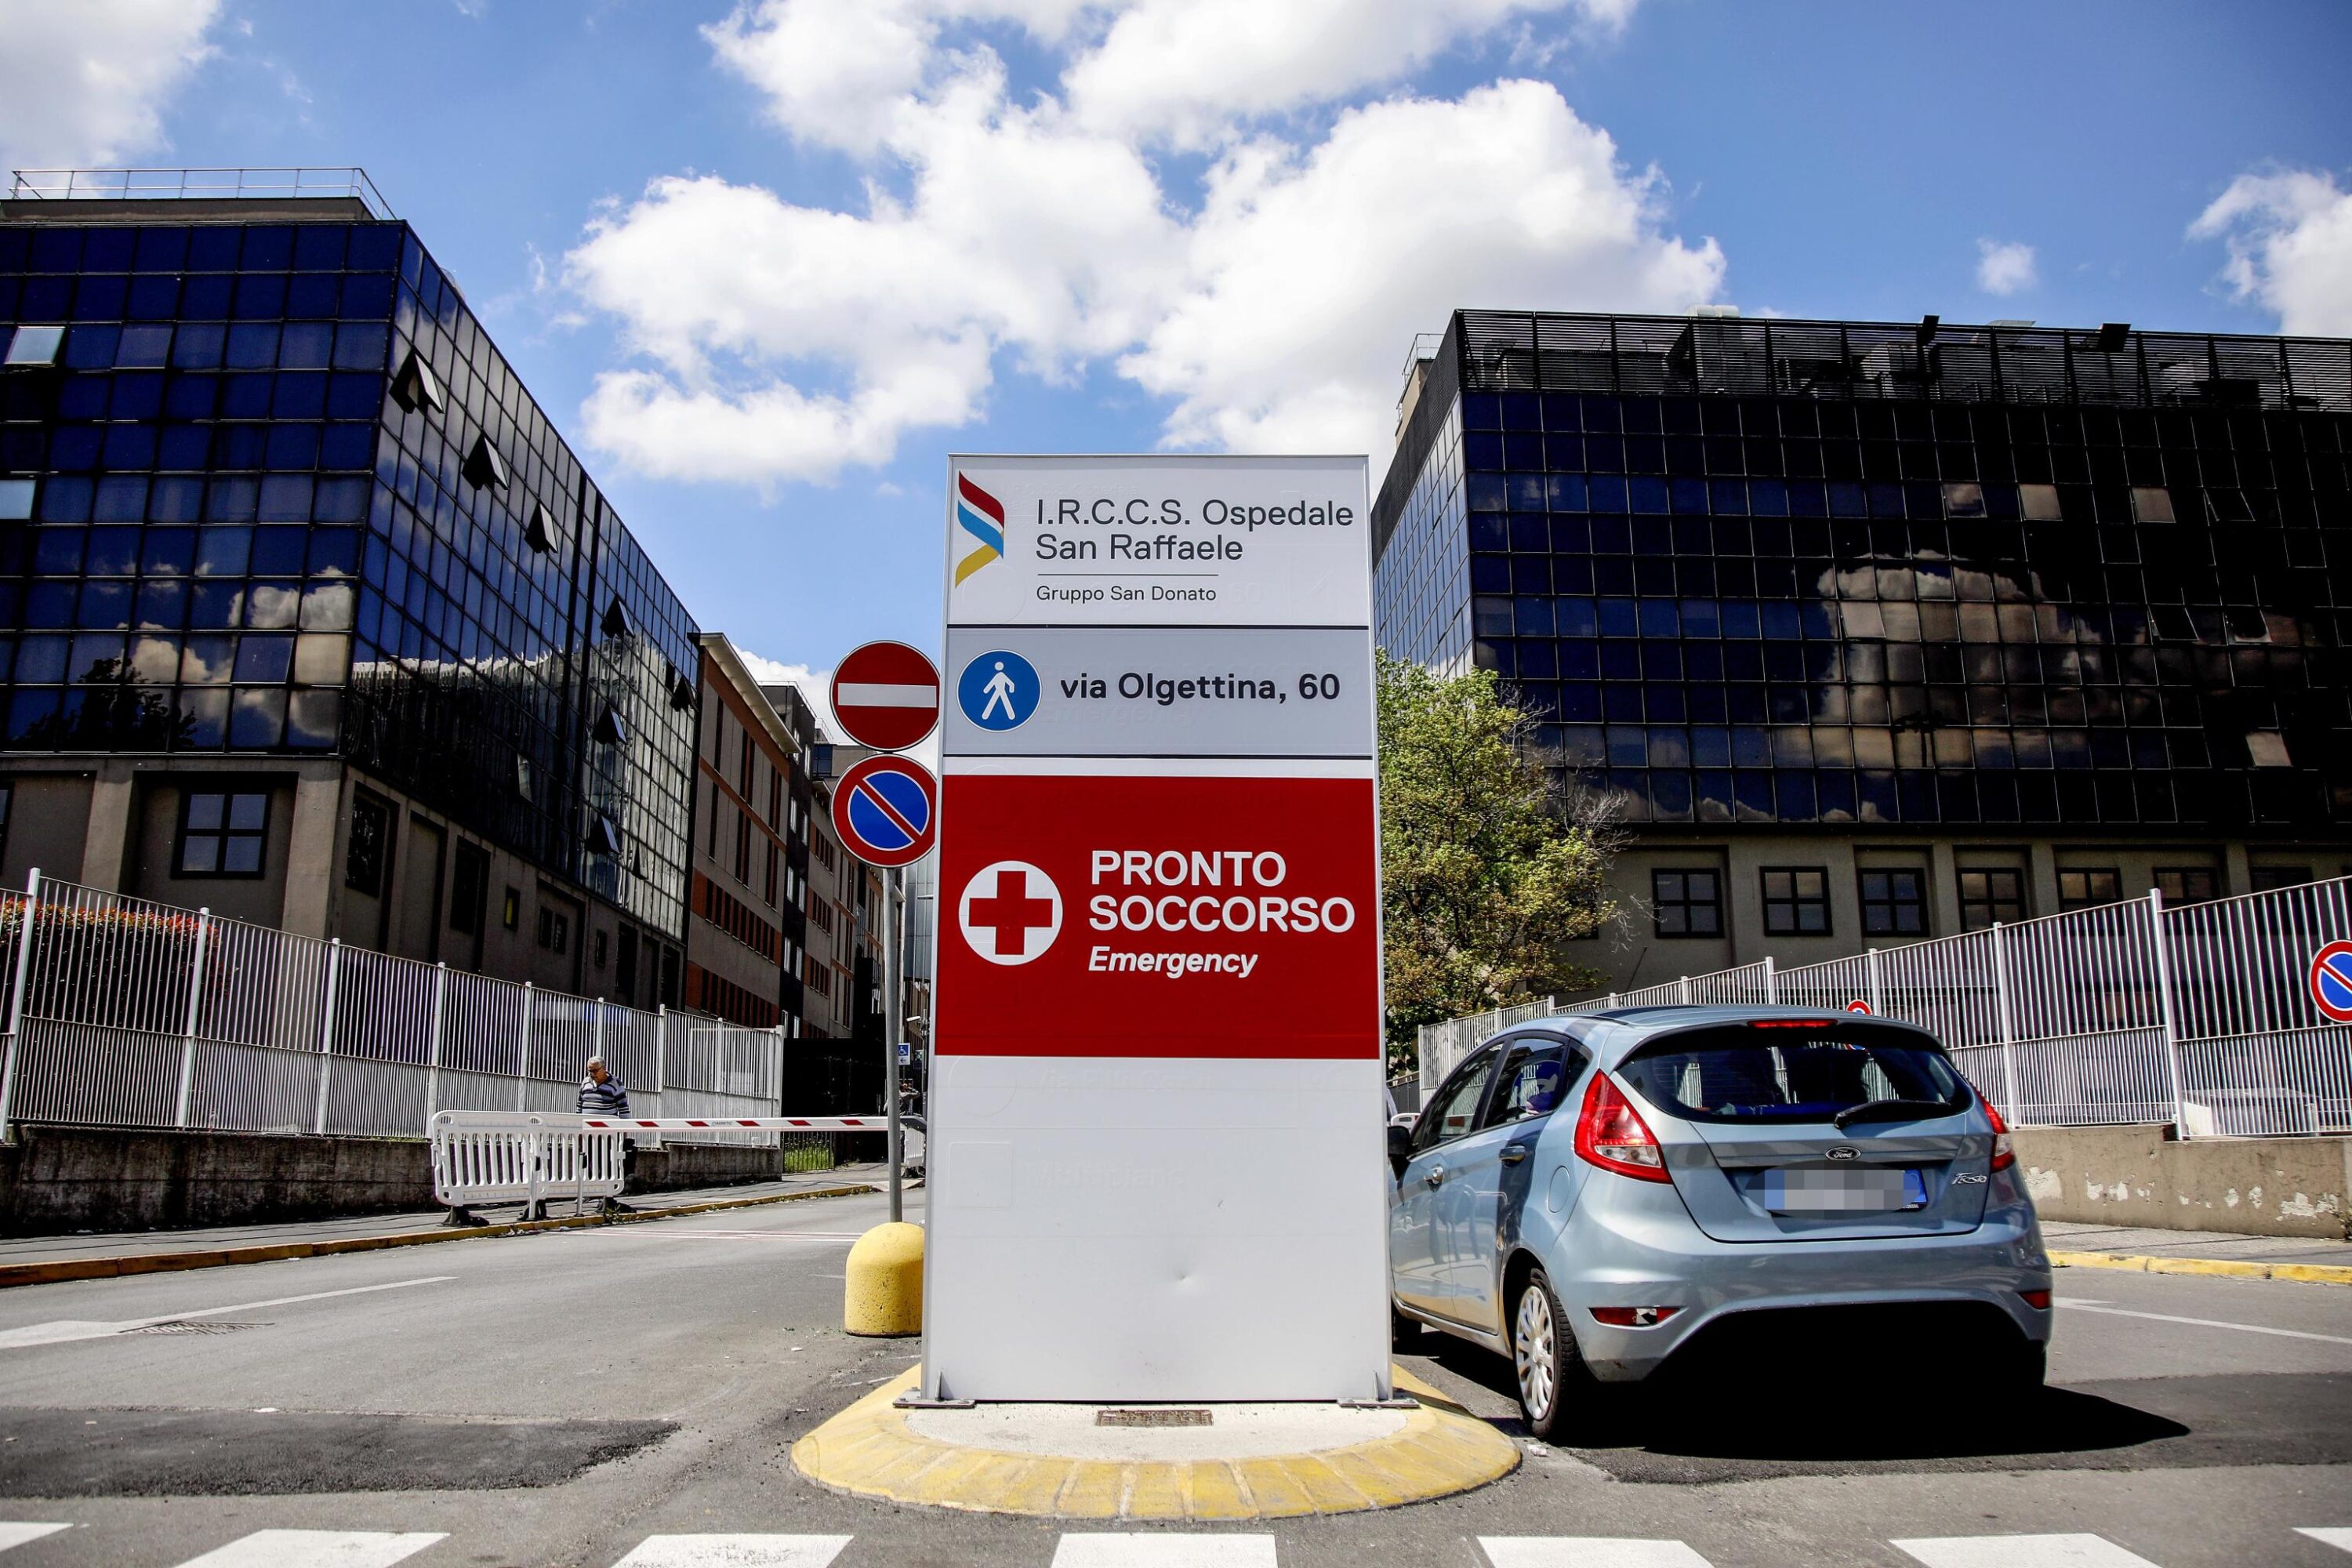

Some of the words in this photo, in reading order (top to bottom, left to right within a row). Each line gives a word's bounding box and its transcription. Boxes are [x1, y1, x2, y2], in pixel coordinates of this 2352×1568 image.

[1037, 499, 1190, 525] I.R.C.C.S.
[1203, 499, 1354, 532] Ospedale
[1036, 533, 1097, 560] San
[1110, 533, 1243, 561] Raffaele
[1036, 585, 1105, 604] Gruppo
[1110, 585, 1145, 601] San
[1152, 586, 1217, 601] Donato
[1060, 672, 1107, 699] via
[1118, 672, 1287, 706] Olgettina,
[1298, 673, 1341, 700] 60
[1091, 850, 1287, 887] PRONTO
[1089, 895, 1356, 933] SOCCORSO
[1088, 946, 1258, 979] Emergency
[1951, 1172, 1987, 1185] Fiesta
